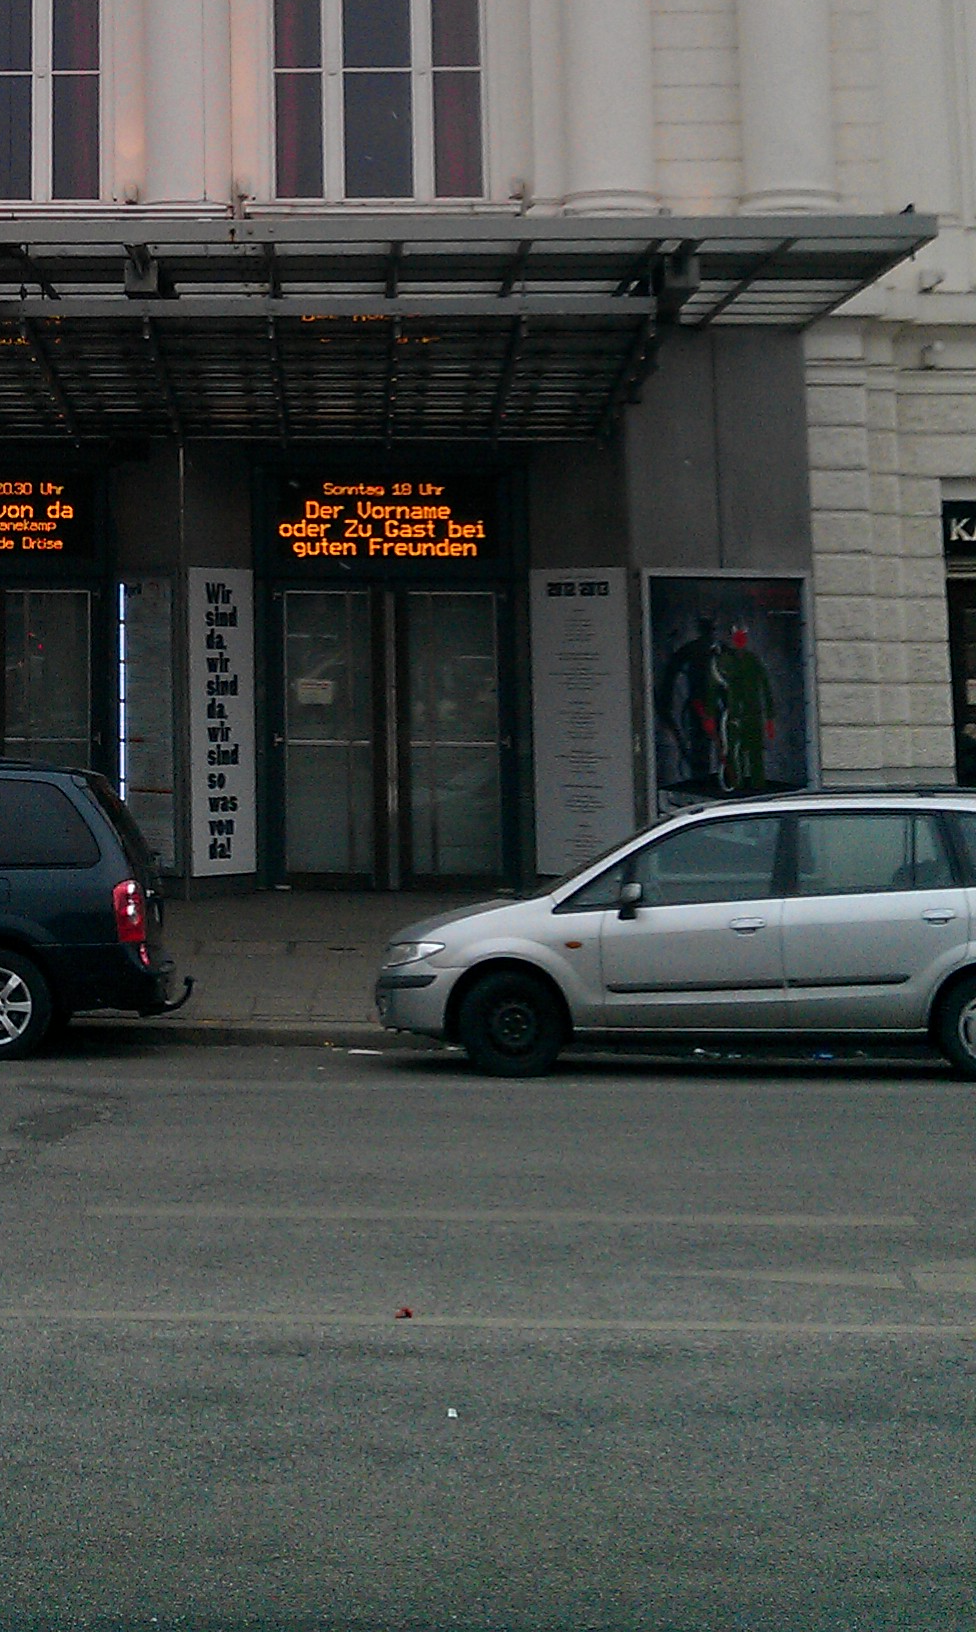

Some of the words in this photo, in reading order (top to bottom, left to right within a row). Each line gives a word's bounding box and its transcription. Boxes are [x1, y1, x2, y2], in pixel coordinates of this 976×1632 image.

[40, 483, 64, 495] Uhr
[323, 483, 384, 495] Sonntag
[392, 484, 412, 495] 18
[419, 484, 445, 495] Uhr
[47, 501, 74, 518] da
[306, 501, 344, 518] Der
[358, 501, 451, 519] Vorname
[279, 521, 331, 537] oder
[344, 520, 372, 537] Zu
[385, 520, 437, 537] Gast
[448, 521, 486, 537] bei
[293, 539, 356, 557] guten
[369, 539, 477, 556] Freunden
[206, 583, 232, 604] Wir
[206, 608, 237, 627] sind
[206, 652, 230, 672] wir
[206, 676, 238, 696] sind
[208, 722, 230, 742] wir
[207, 744, 238, 766] sind
[208, 772, 225, 789] so
[209, 795, 238, 812] was
[209, 819, 234, 836] von
[209, 838, 231, 859] da!
